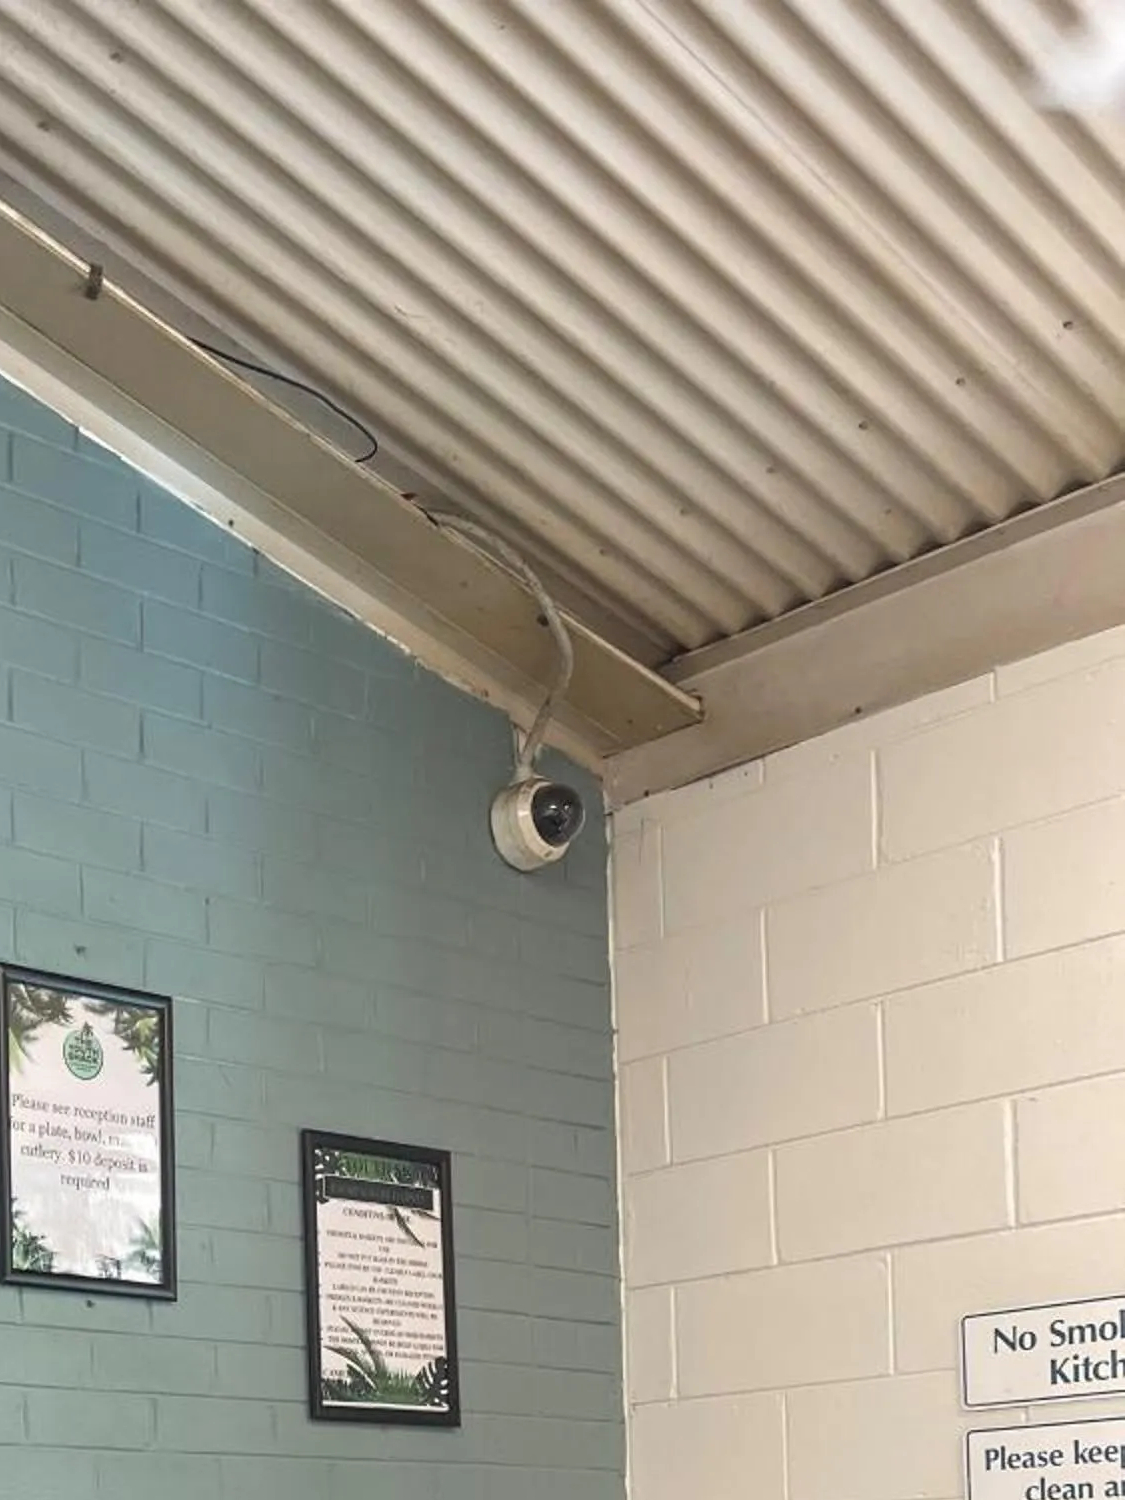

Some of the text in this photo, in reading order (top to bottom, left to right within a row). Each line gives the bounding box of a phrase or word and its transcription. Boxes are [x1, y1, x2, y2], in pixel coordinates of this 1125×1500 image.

[12, 1093, 155, 1129] Please see reception staff
[68, 1148, 92, 1165] $10
[94, 1152, 136, 1173] deposit
[60, 1173, 110, 1191] required
[993, 1325, 1037, 1354] No
[985, 1445, 1064, 1471] Please
